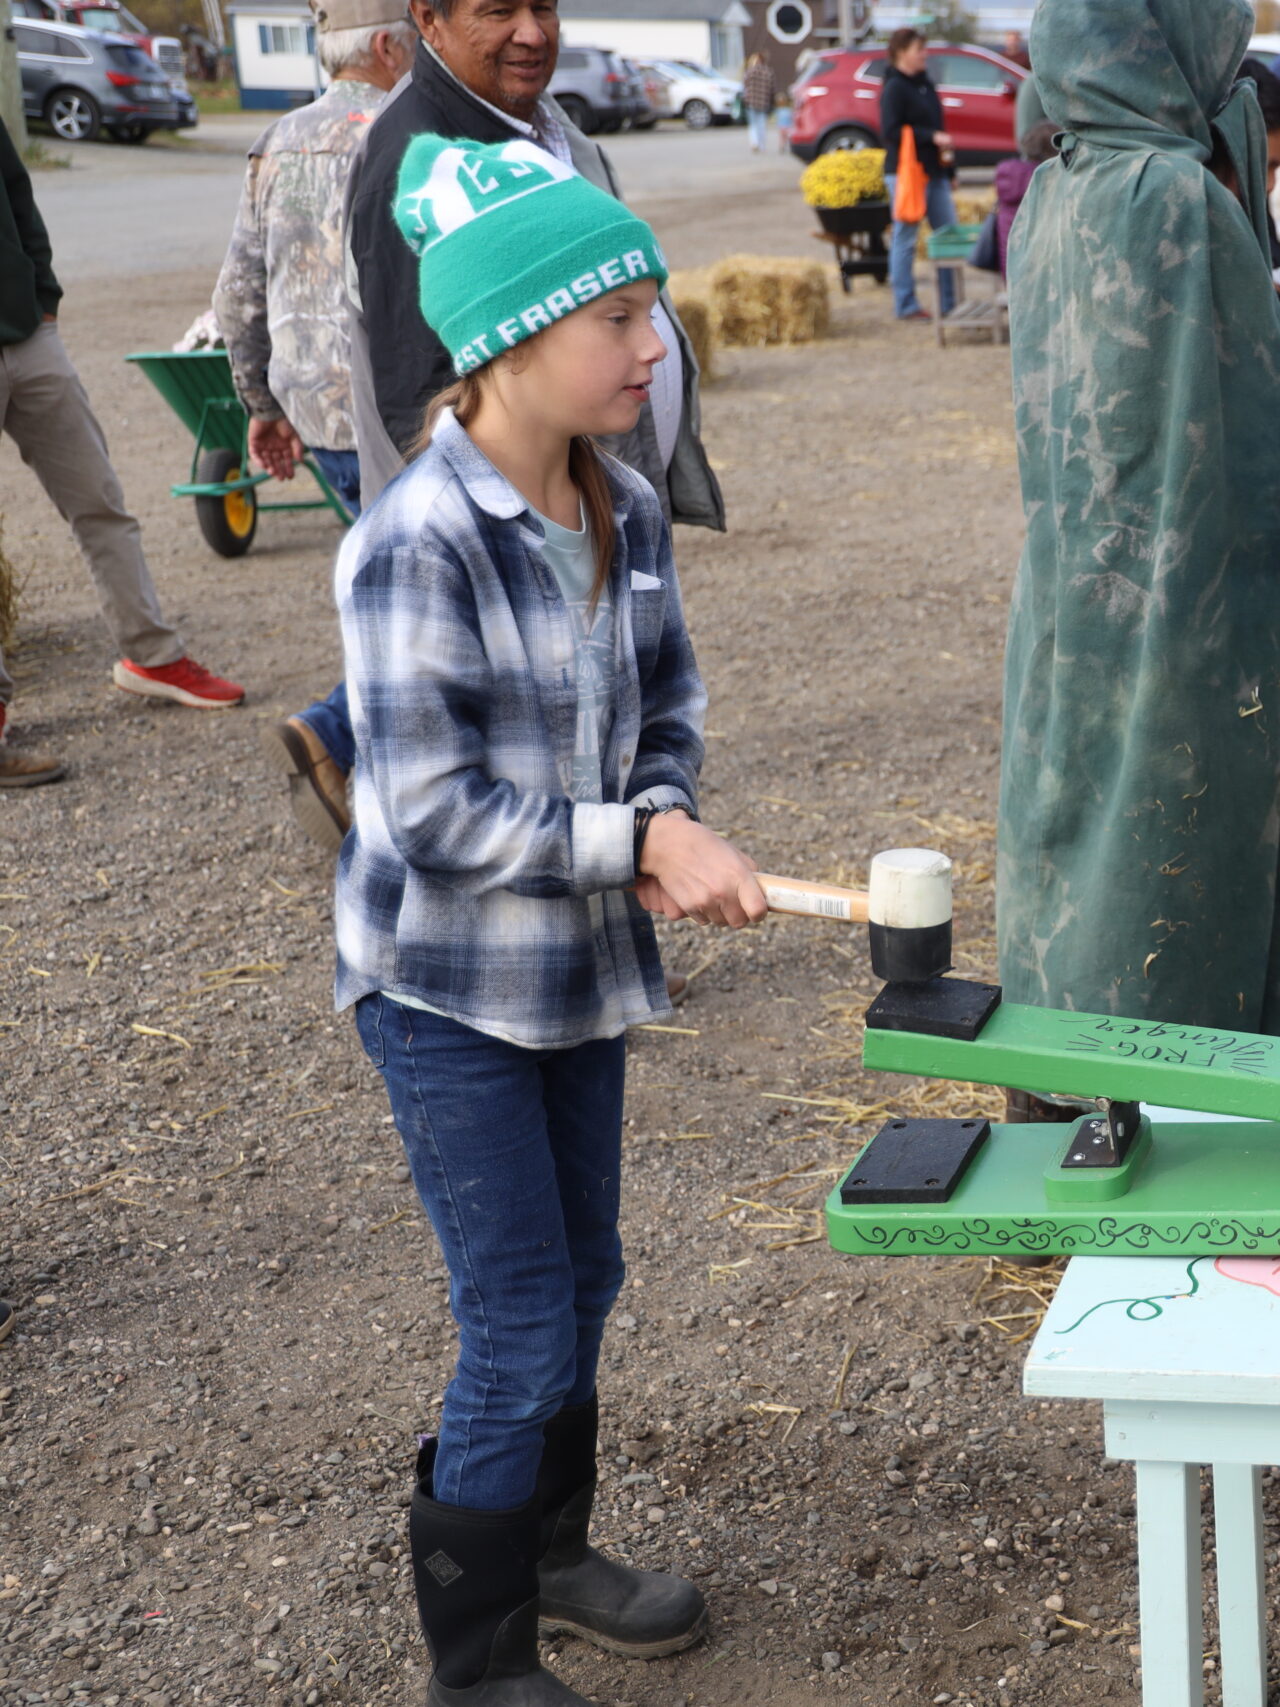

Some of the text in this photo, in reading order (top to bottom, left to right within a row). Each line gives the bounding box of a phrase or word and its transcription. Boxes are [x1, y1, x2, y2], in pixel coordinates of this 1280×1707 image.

[454, 334, 494, 376] EST
[496, 249, 649, 345] FRASER
[1118, 1041, 1216, 1067] FROG
